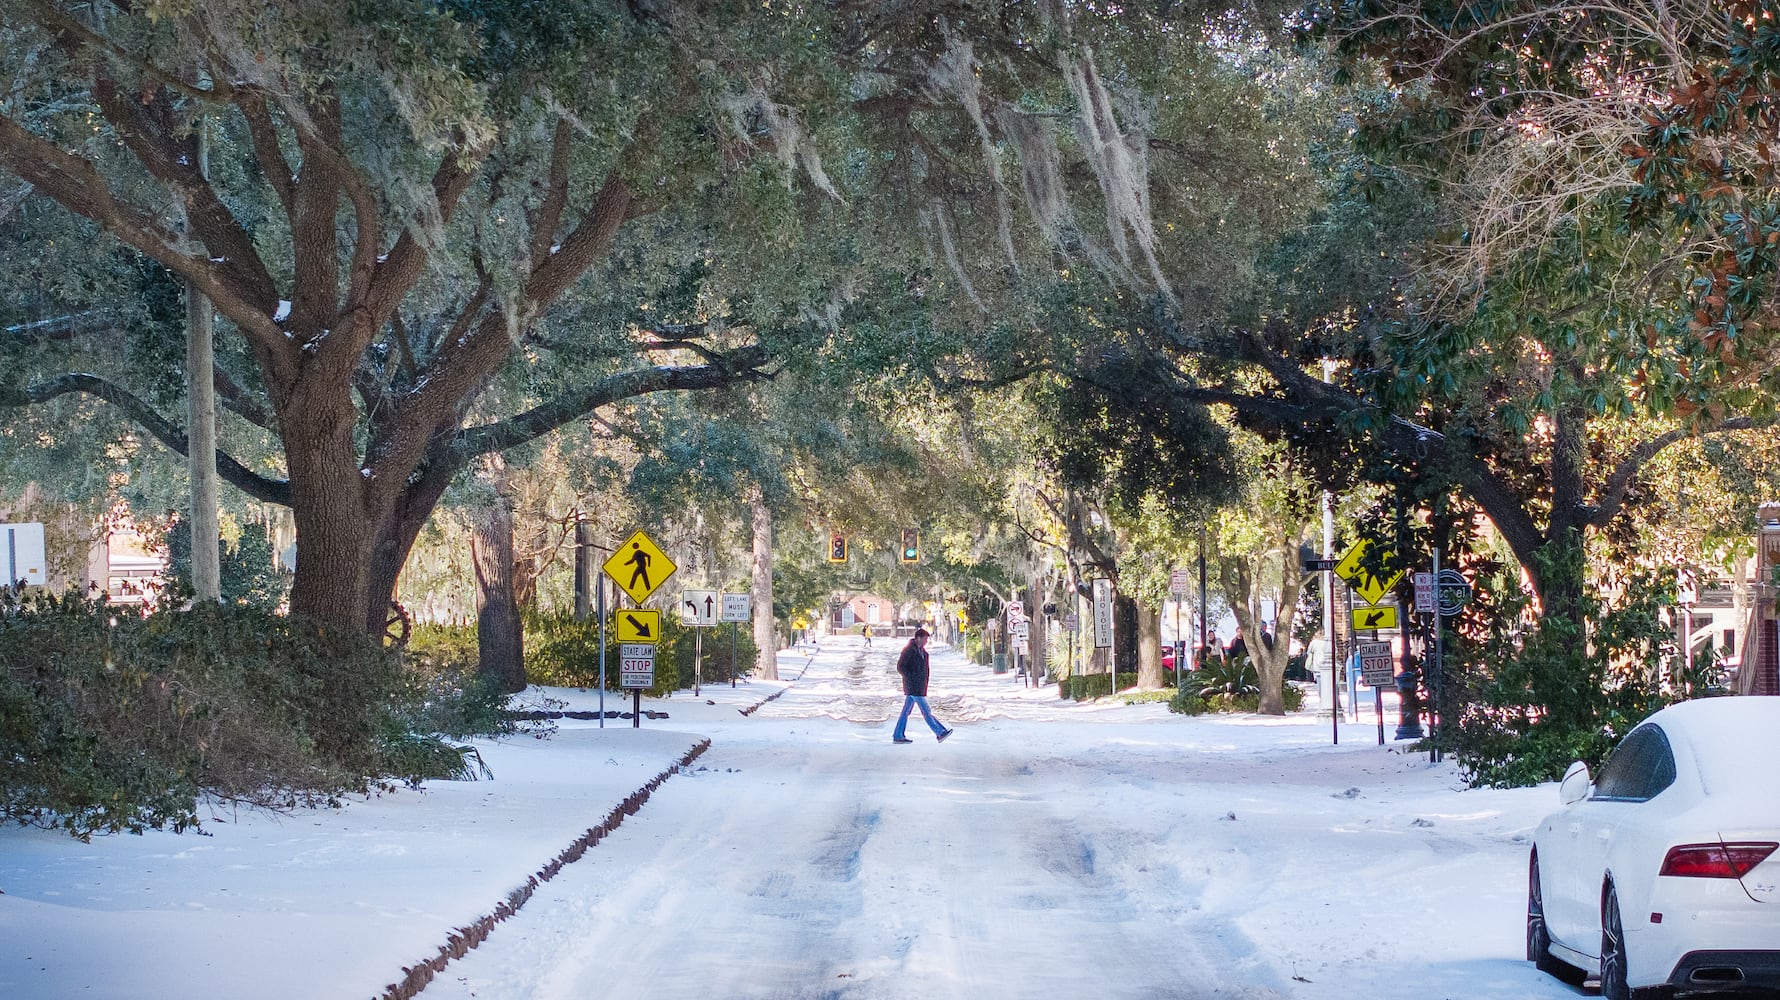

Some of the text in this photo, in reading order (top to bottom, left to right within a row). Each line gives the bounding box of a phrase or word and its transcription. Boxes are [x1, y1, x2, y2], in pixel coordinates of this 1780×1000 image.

[623, 646, 652, 656] STATE LAW
[1361, 645, 1390, 655] STATE LAW
[624, 660, 651, 671] STOP
[1364, 658, 1390, 670] STOP
